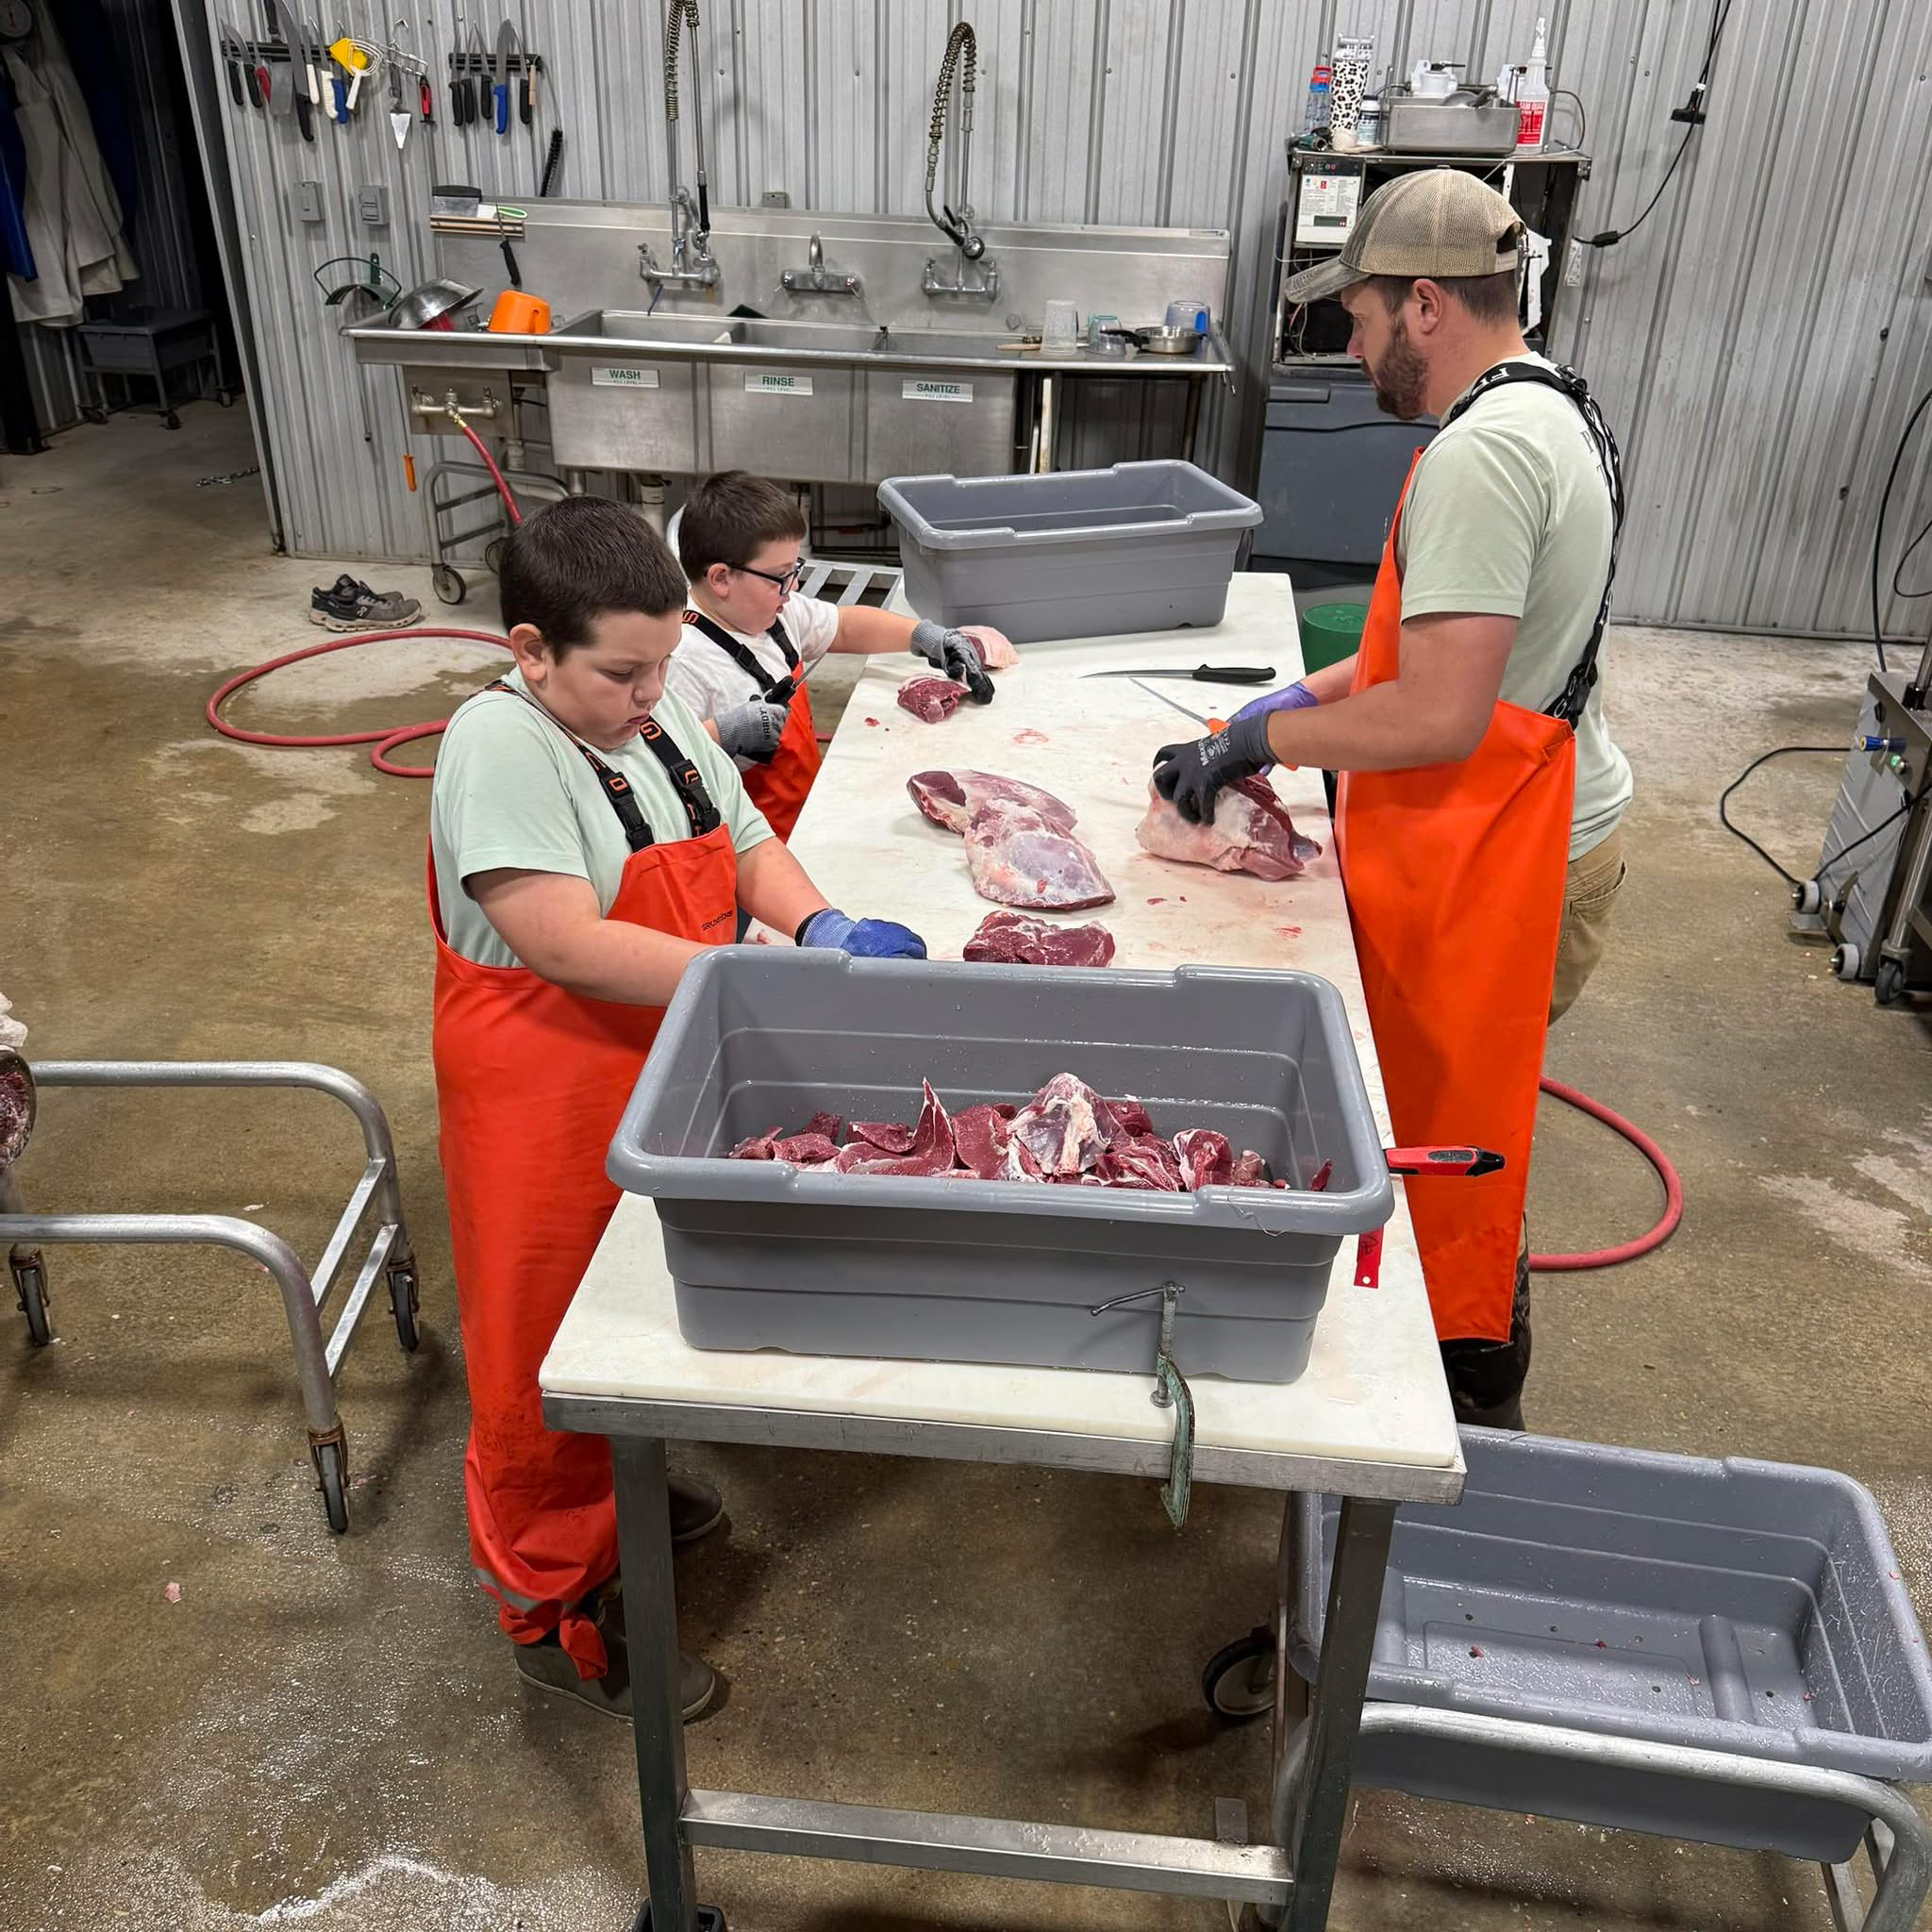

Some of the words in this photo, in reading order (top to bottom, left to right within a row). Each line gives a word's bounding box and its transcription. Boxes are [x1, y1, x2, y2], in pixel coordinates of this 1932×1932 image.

[608, 369, 641, 380] WASH
[762, 375, 795, 387] RINSE
[916, 383, 961, 394] SANITIZE
